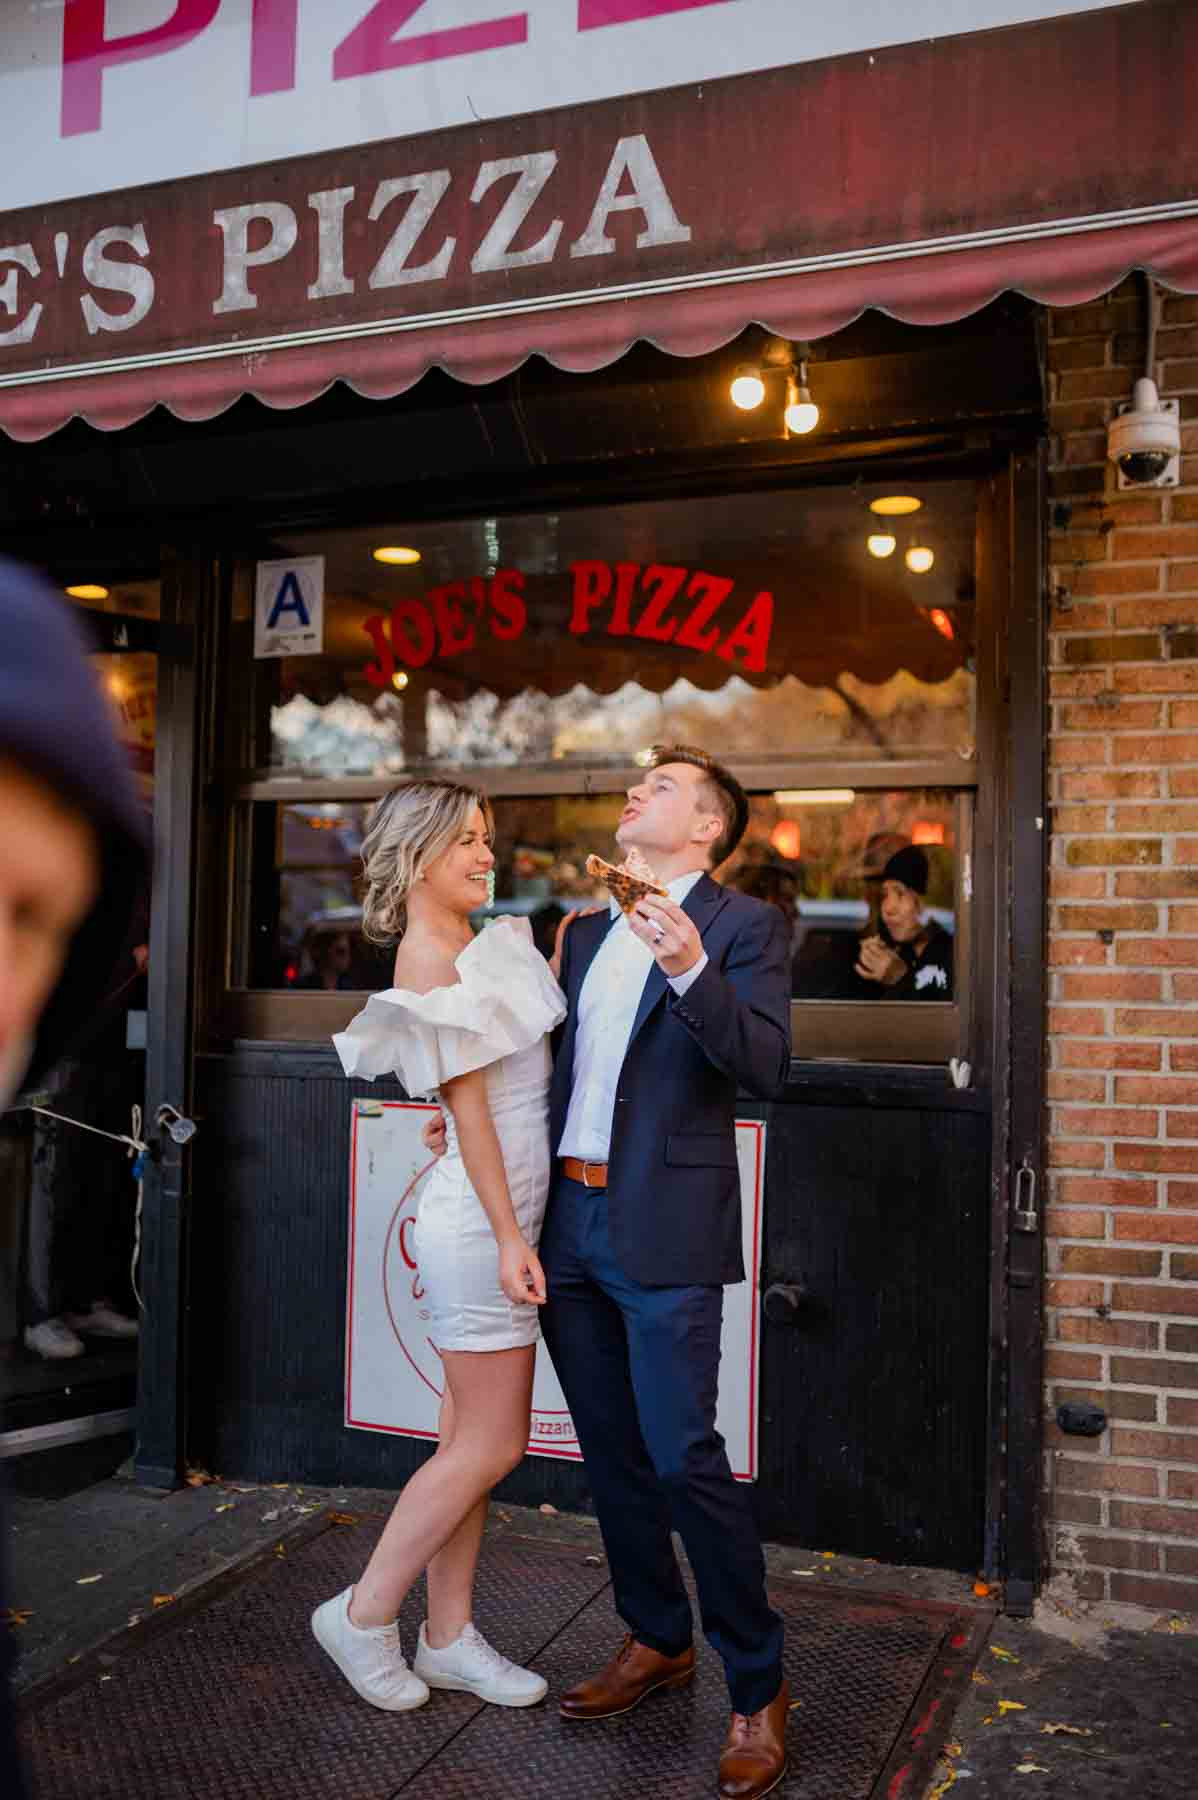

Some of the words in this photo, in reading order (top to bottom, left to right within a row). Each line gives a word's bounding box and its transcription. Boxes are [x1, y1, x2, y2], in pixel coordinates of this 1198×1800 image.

[212, 133, 691, 315] PIZZA
[266, 571, 310, 629] A
[361, 569, 528, 688] JOE'S
[568, 560, 775, 674] PIZZA
